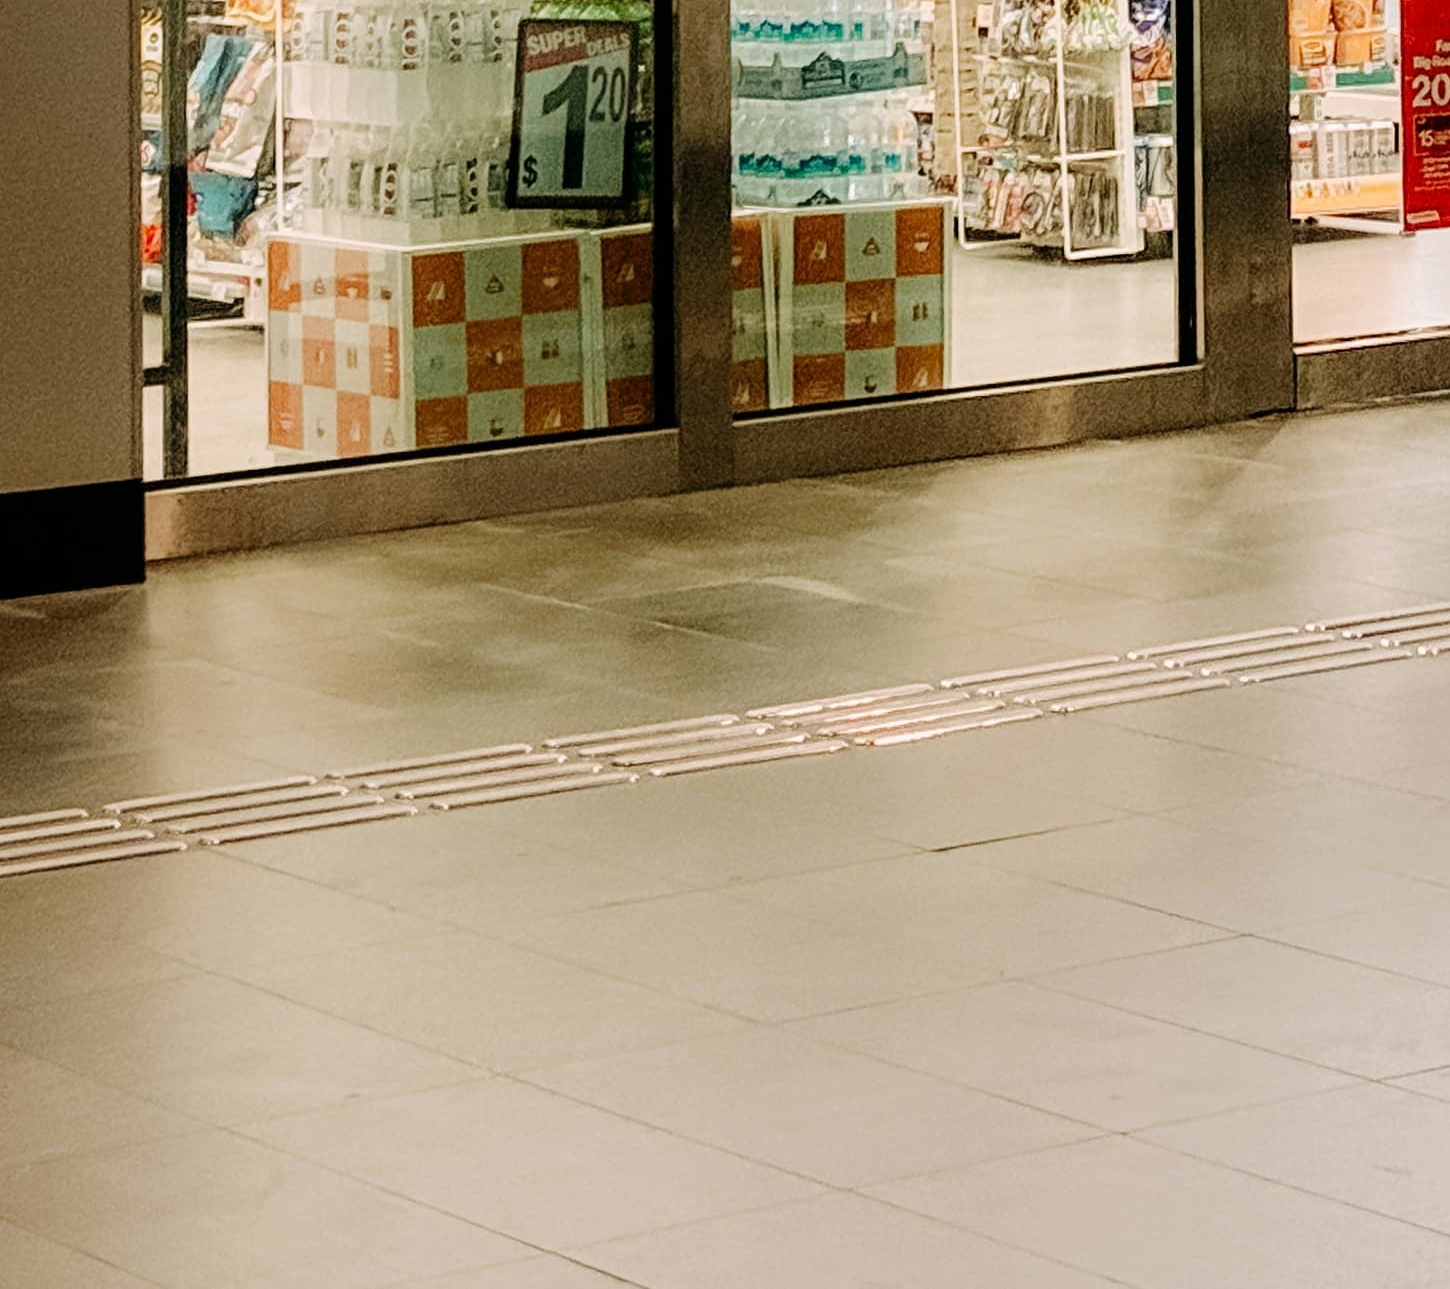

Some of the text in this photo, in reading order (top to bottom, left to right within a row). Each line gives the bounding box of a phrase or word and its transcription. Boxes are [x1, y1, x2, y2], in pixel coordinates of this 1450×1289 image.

[526, 25, 631, 56] SUPER DEALS
[521, 154, 539, 189] $
